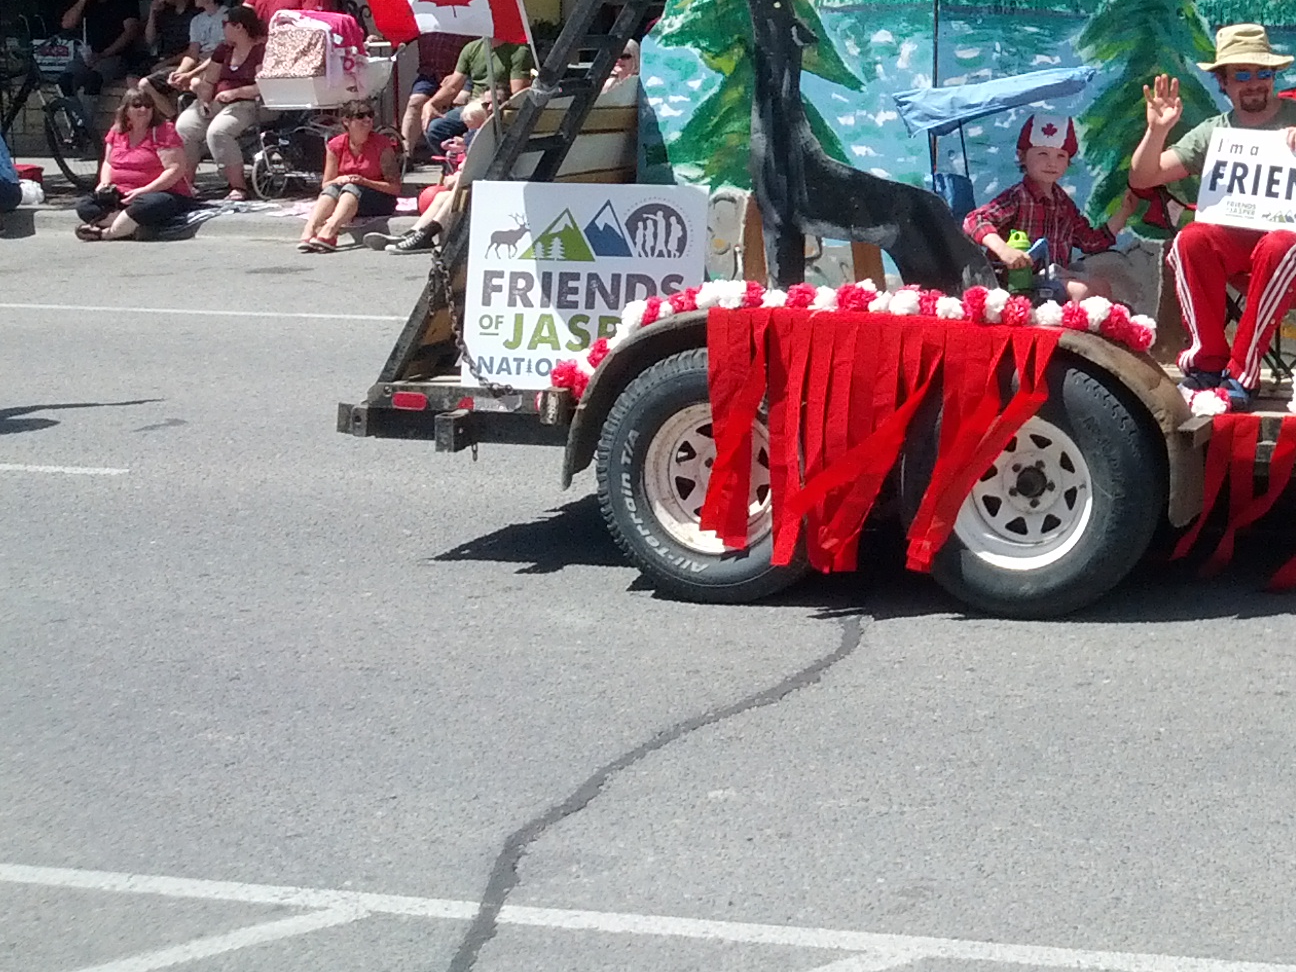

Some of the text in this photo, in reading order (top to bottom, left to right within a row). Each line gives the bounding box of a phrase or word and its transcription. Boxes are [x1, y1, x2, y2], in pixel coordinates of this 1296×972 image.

[1250, 146, 1259, 156] a
[481, 270, 685, 310] FRIENDS
[478, 313, 623, 352] OF JASP
[477, 355, 552, 377] NATIO
